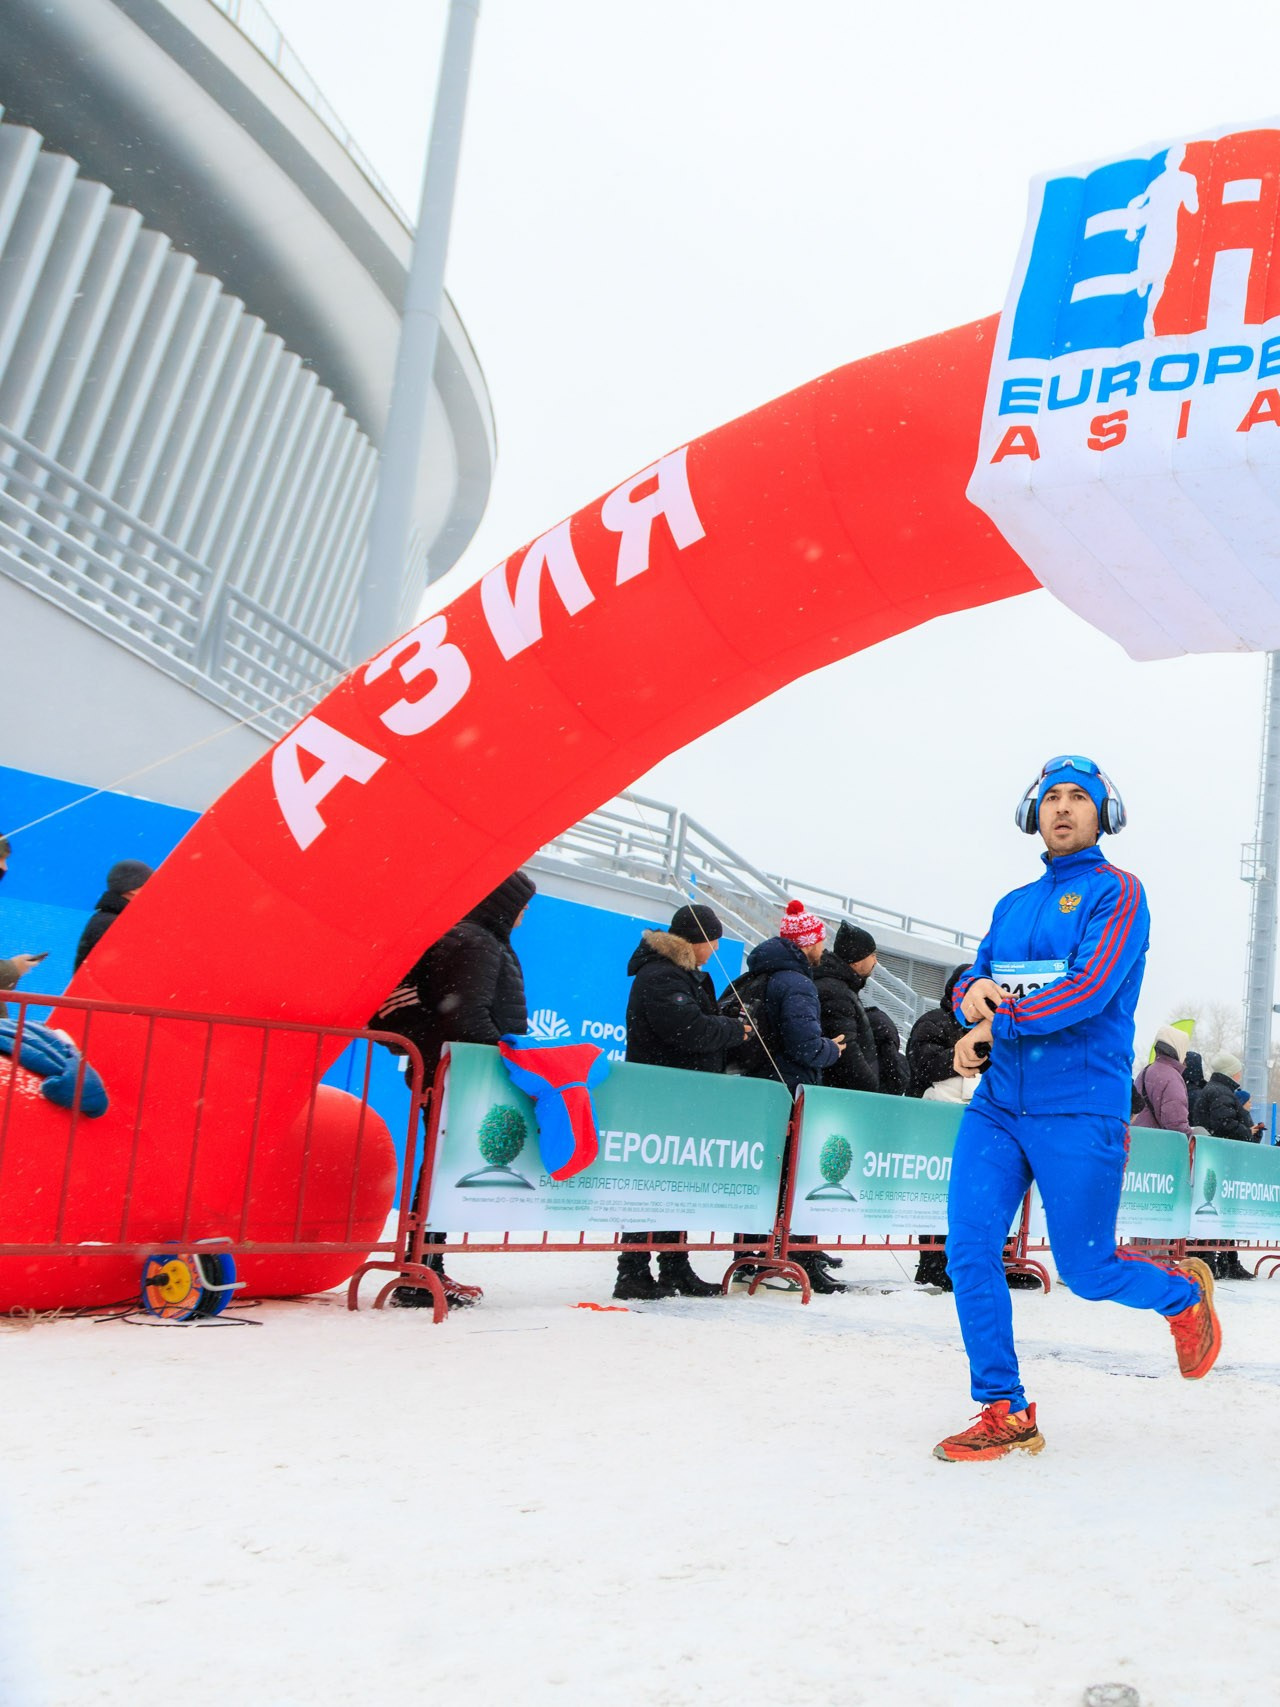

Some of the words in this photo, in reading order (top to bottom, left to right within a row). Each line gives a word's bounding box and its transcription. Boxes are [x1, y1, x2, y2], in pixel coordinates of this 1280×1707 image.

[271, 445, 707, 852] АЗИЯ
[581, 1020, 627, 1046] ГОРО
[599, 1130, 765, 1170] ЕРОЛАКТИС
[577, 1176, 631, 1191] ЯВЛЯЕТСЯ
[631, 1178, 710, 1193] ЛЕКАРСТВЕННЫМ
